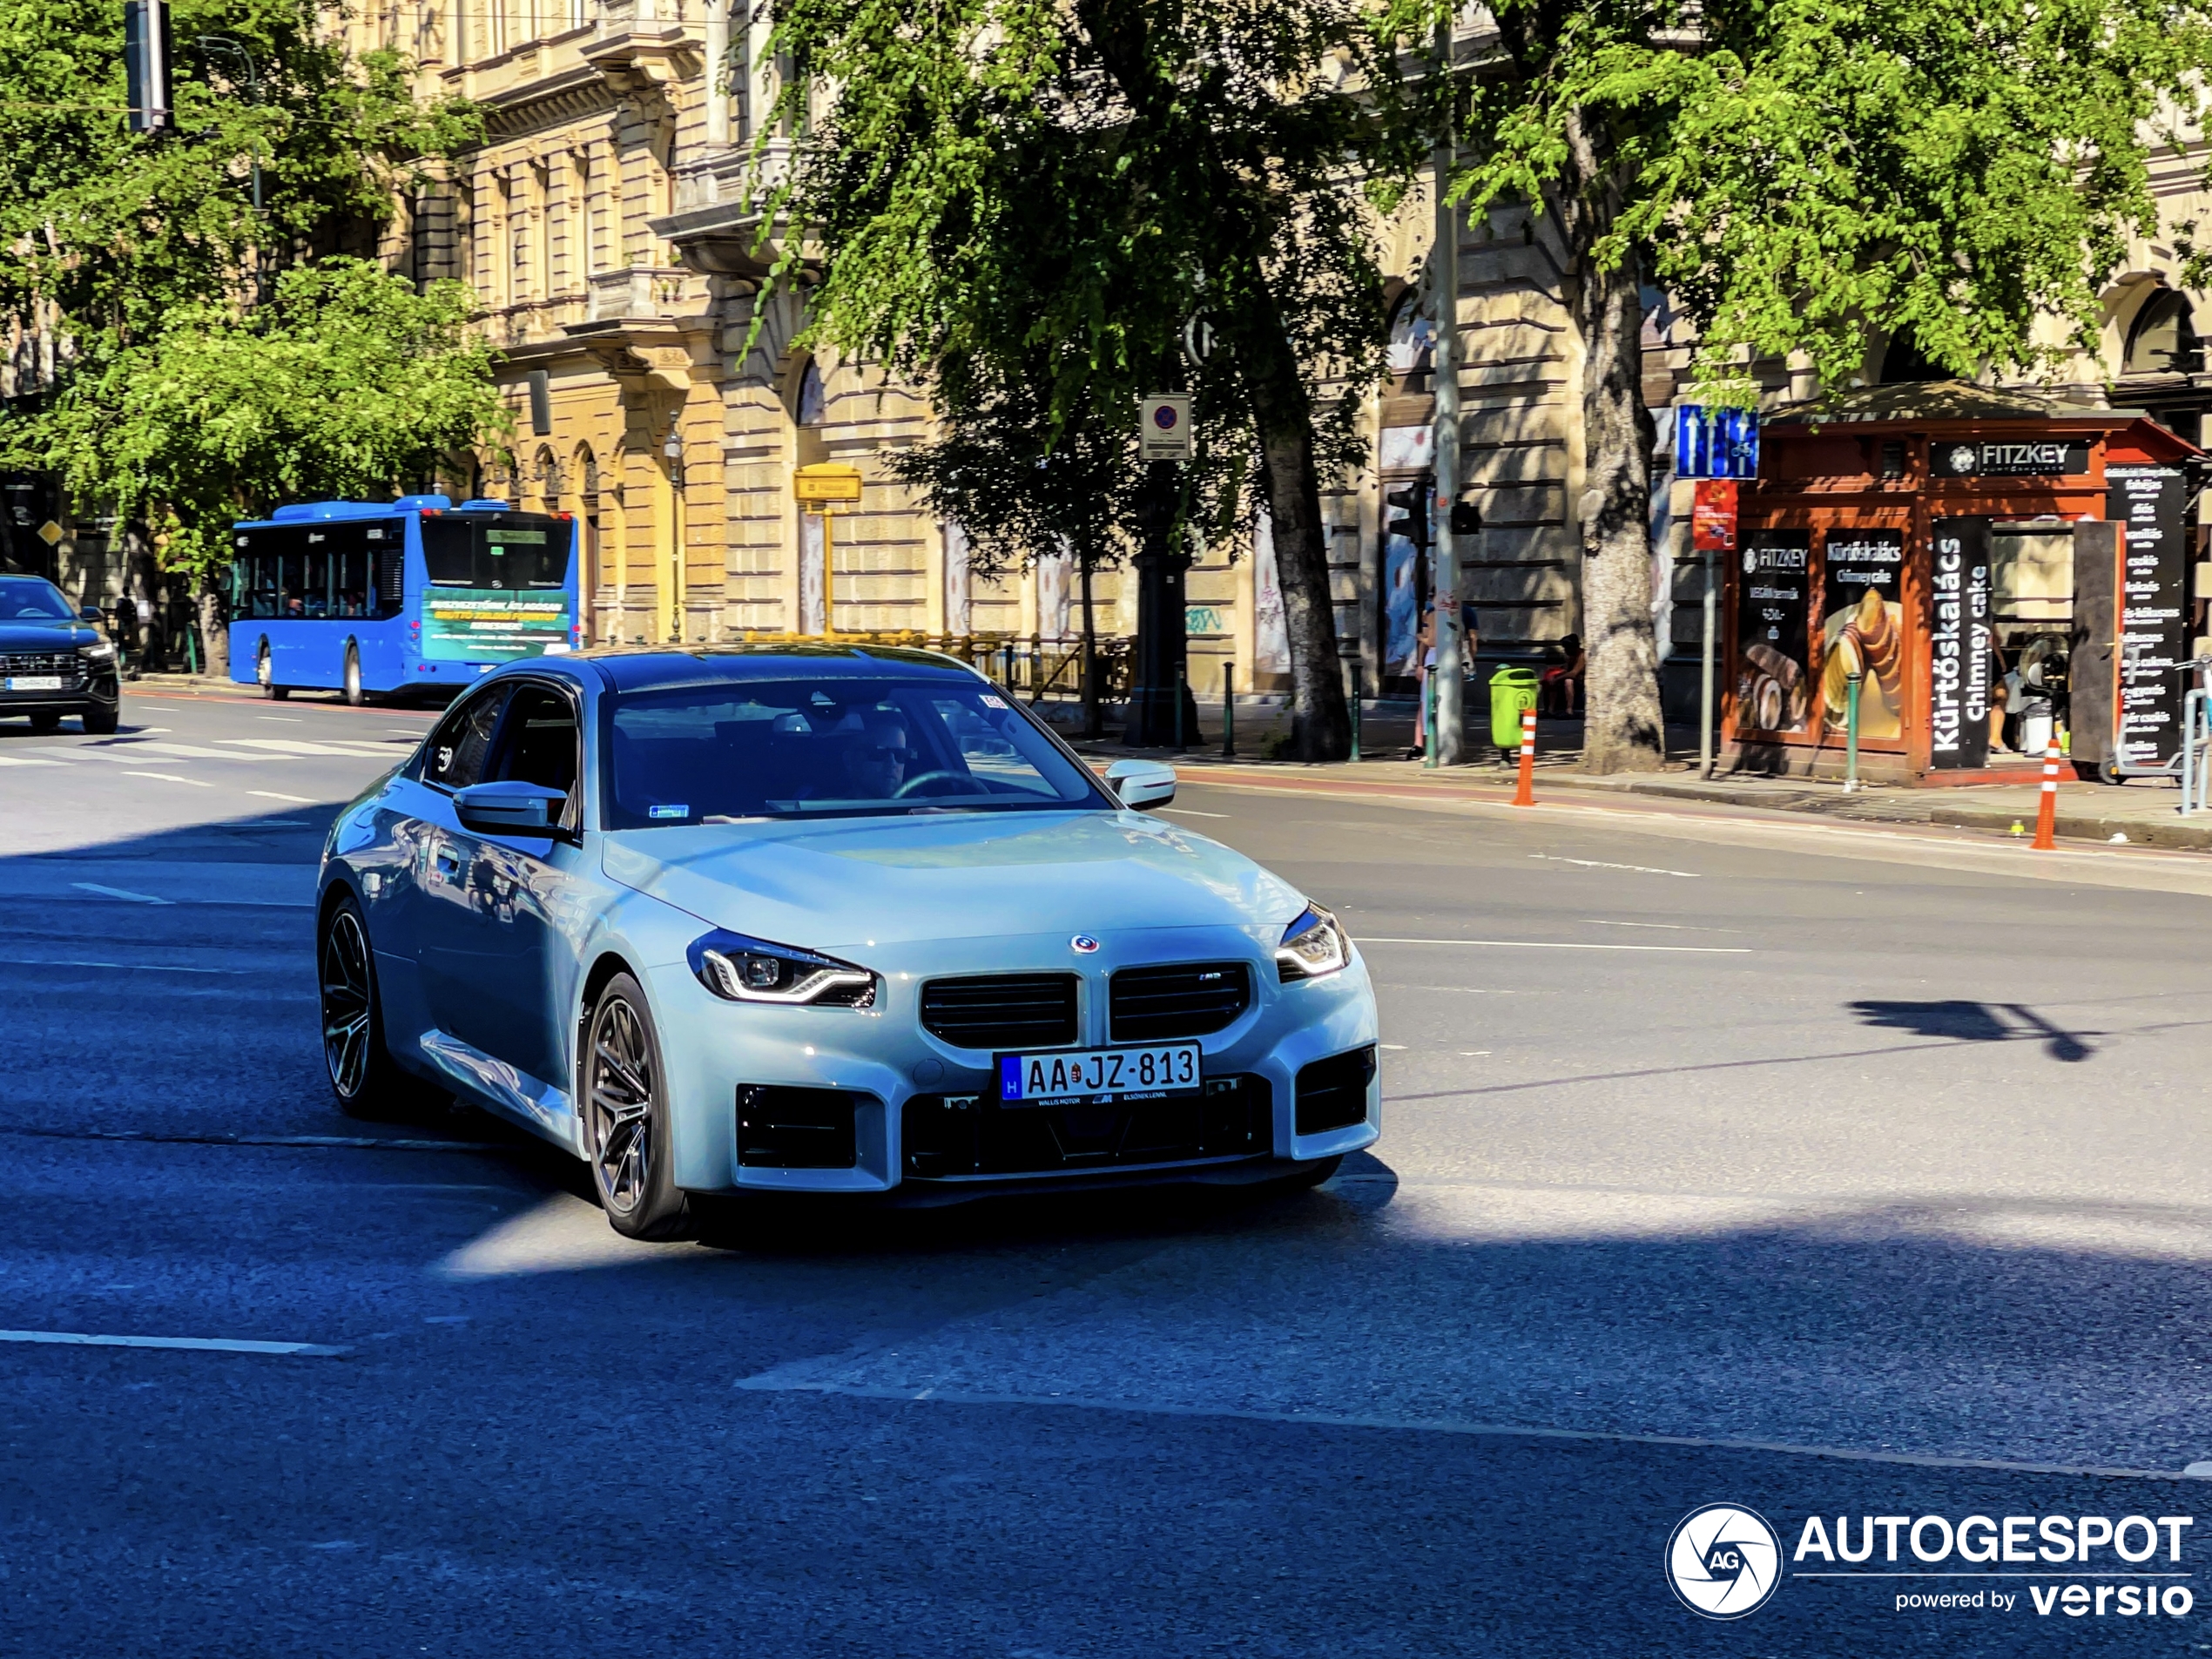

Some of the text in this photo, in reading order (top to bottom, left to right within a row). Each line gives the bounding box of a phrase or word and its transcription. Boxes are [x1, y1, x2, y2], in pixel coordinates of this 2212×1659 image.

[1983, 444, 2070, 465] FITZKEY
[1759, 549, 1809, 567] FITZKEY
[1966, 566, 1987, 618] cake
[1932, 537, 1960, 752] Kürtőskalács
[1028, 1050, 1193, 1094] AA JZ-813
[1007, 1081, 1017, 1094] H
[1038, 1098, 1059, 1107] WALLIS
